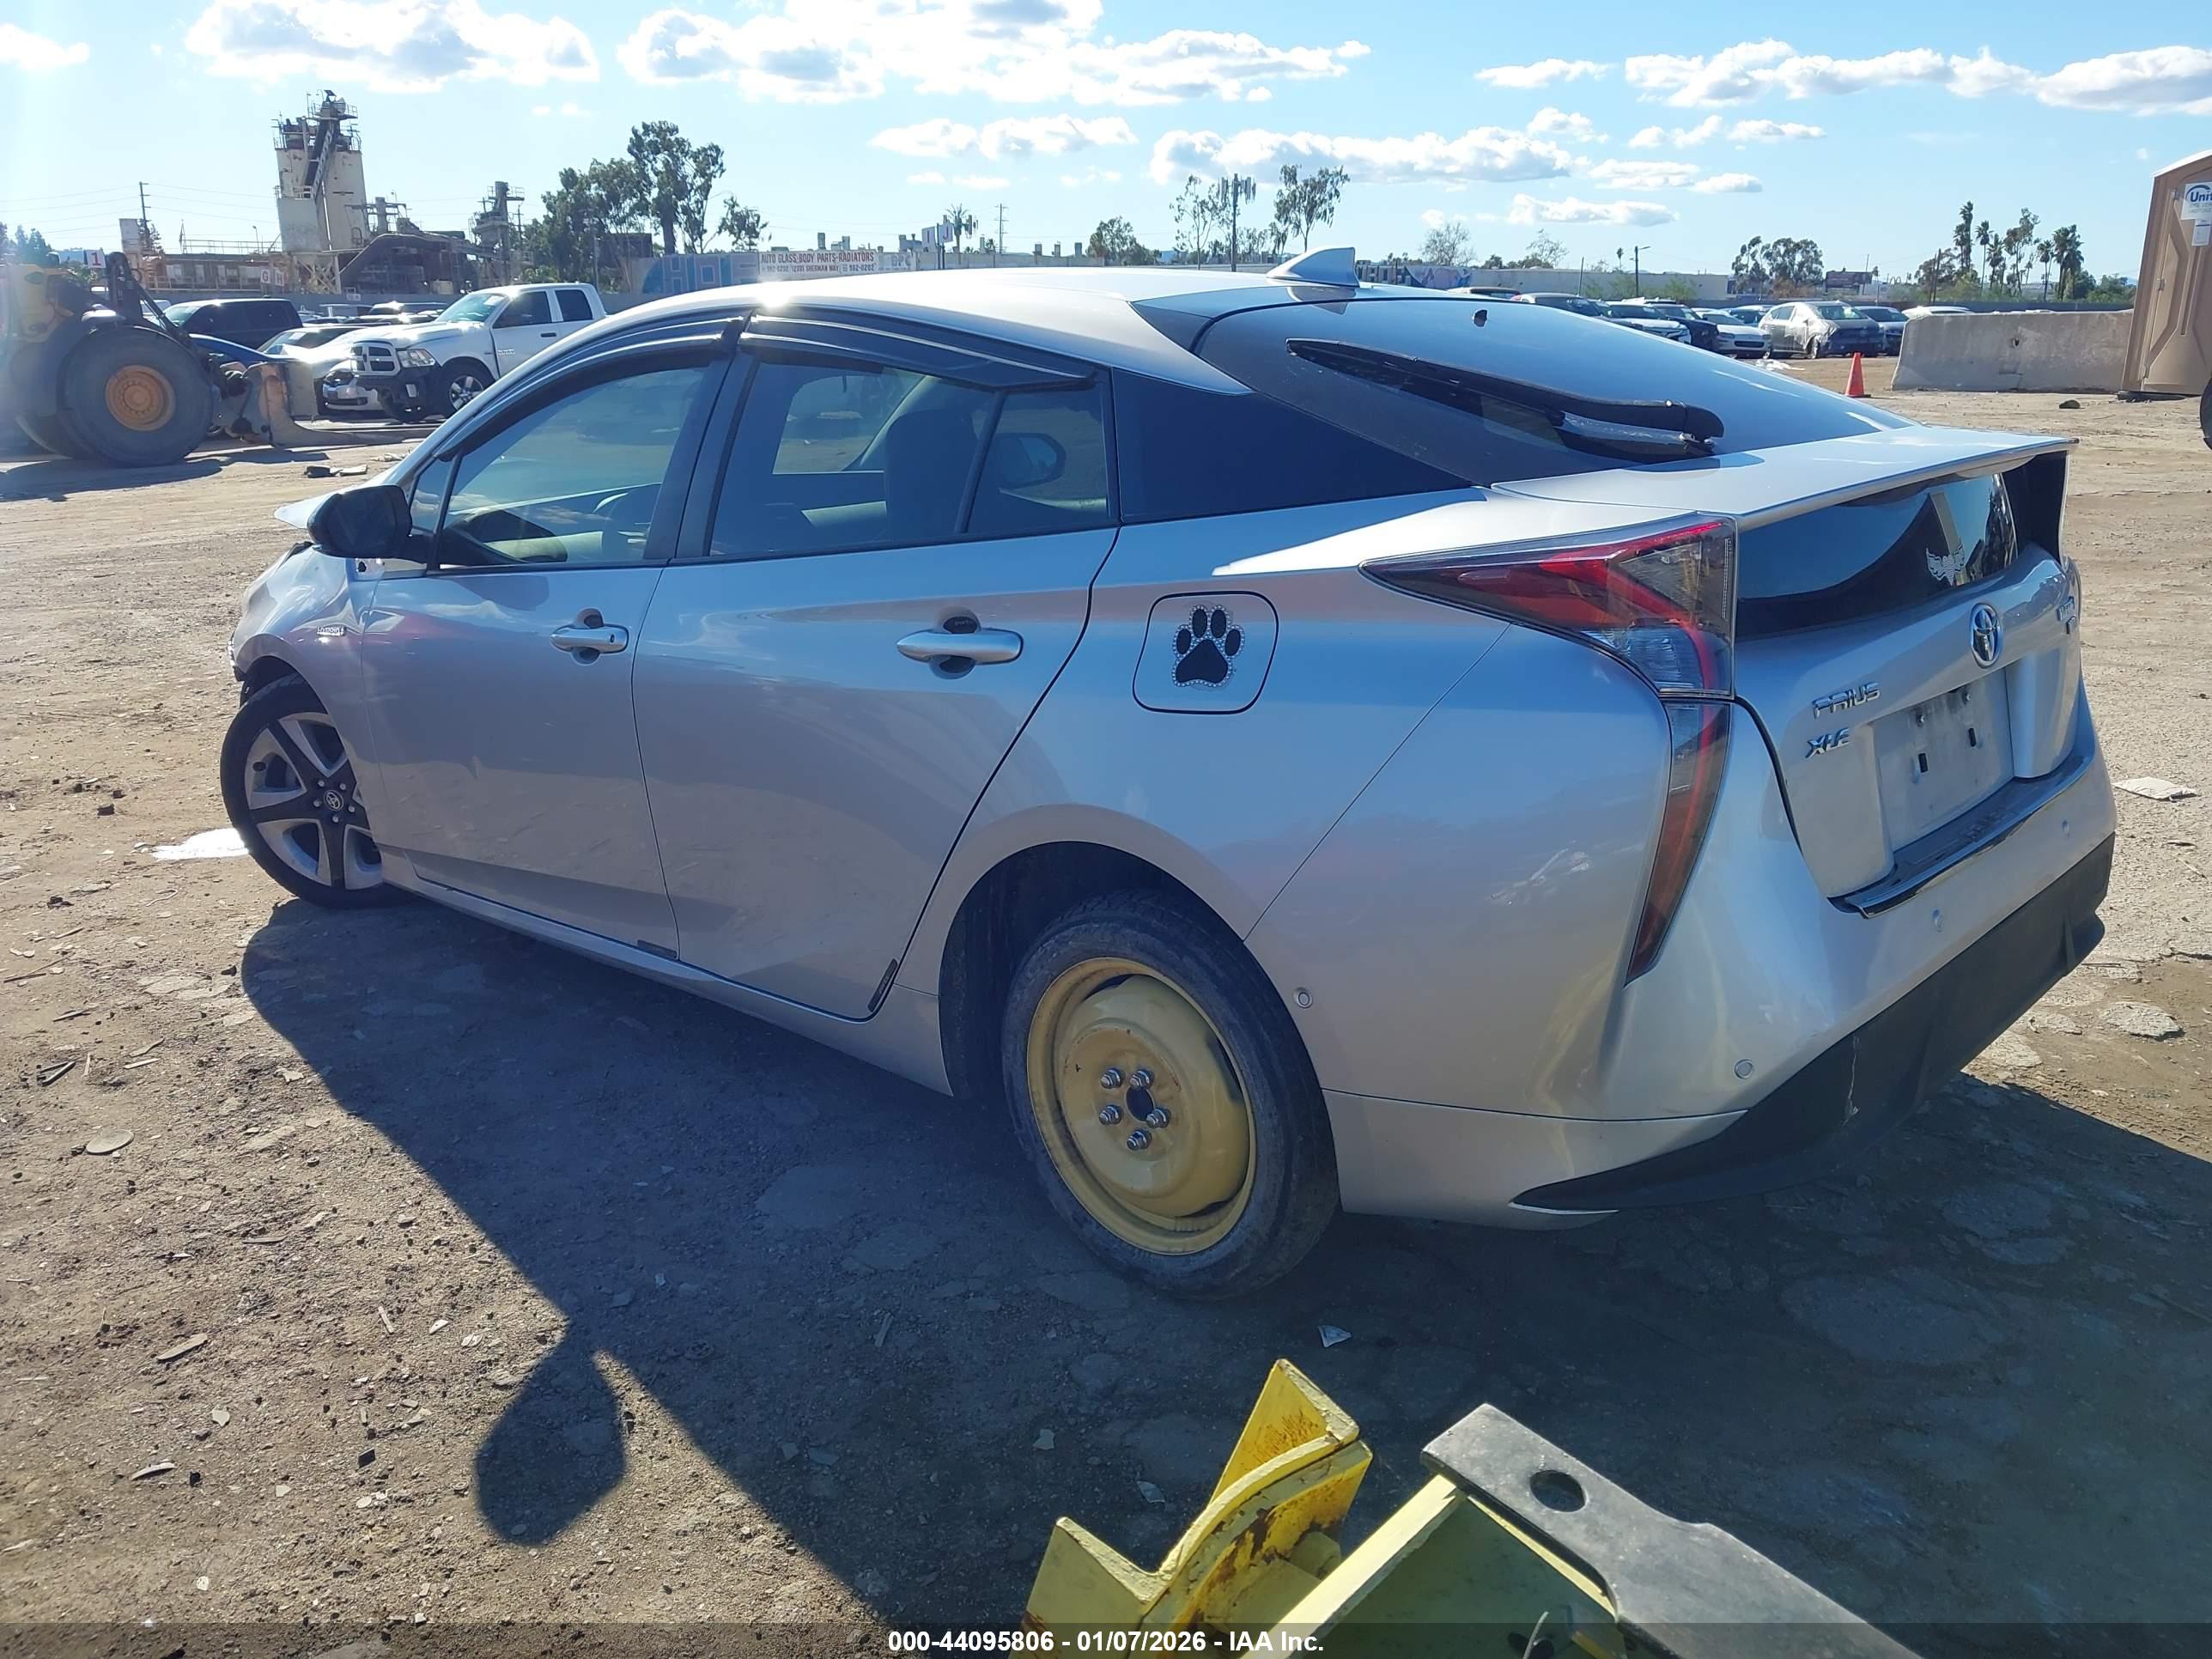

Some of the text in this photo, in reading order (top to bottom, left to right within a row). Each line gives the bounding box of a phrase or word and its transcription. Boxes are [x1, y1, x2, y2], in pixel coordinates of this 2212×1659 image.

[91, 252, 101, 266] 1
[761, 253, 776, 264] AUTO
[262, 270, 269, 283] G
[1813, 682, 1881, 720] PRIUS
[1805, 727, 1850, 759] XLE
